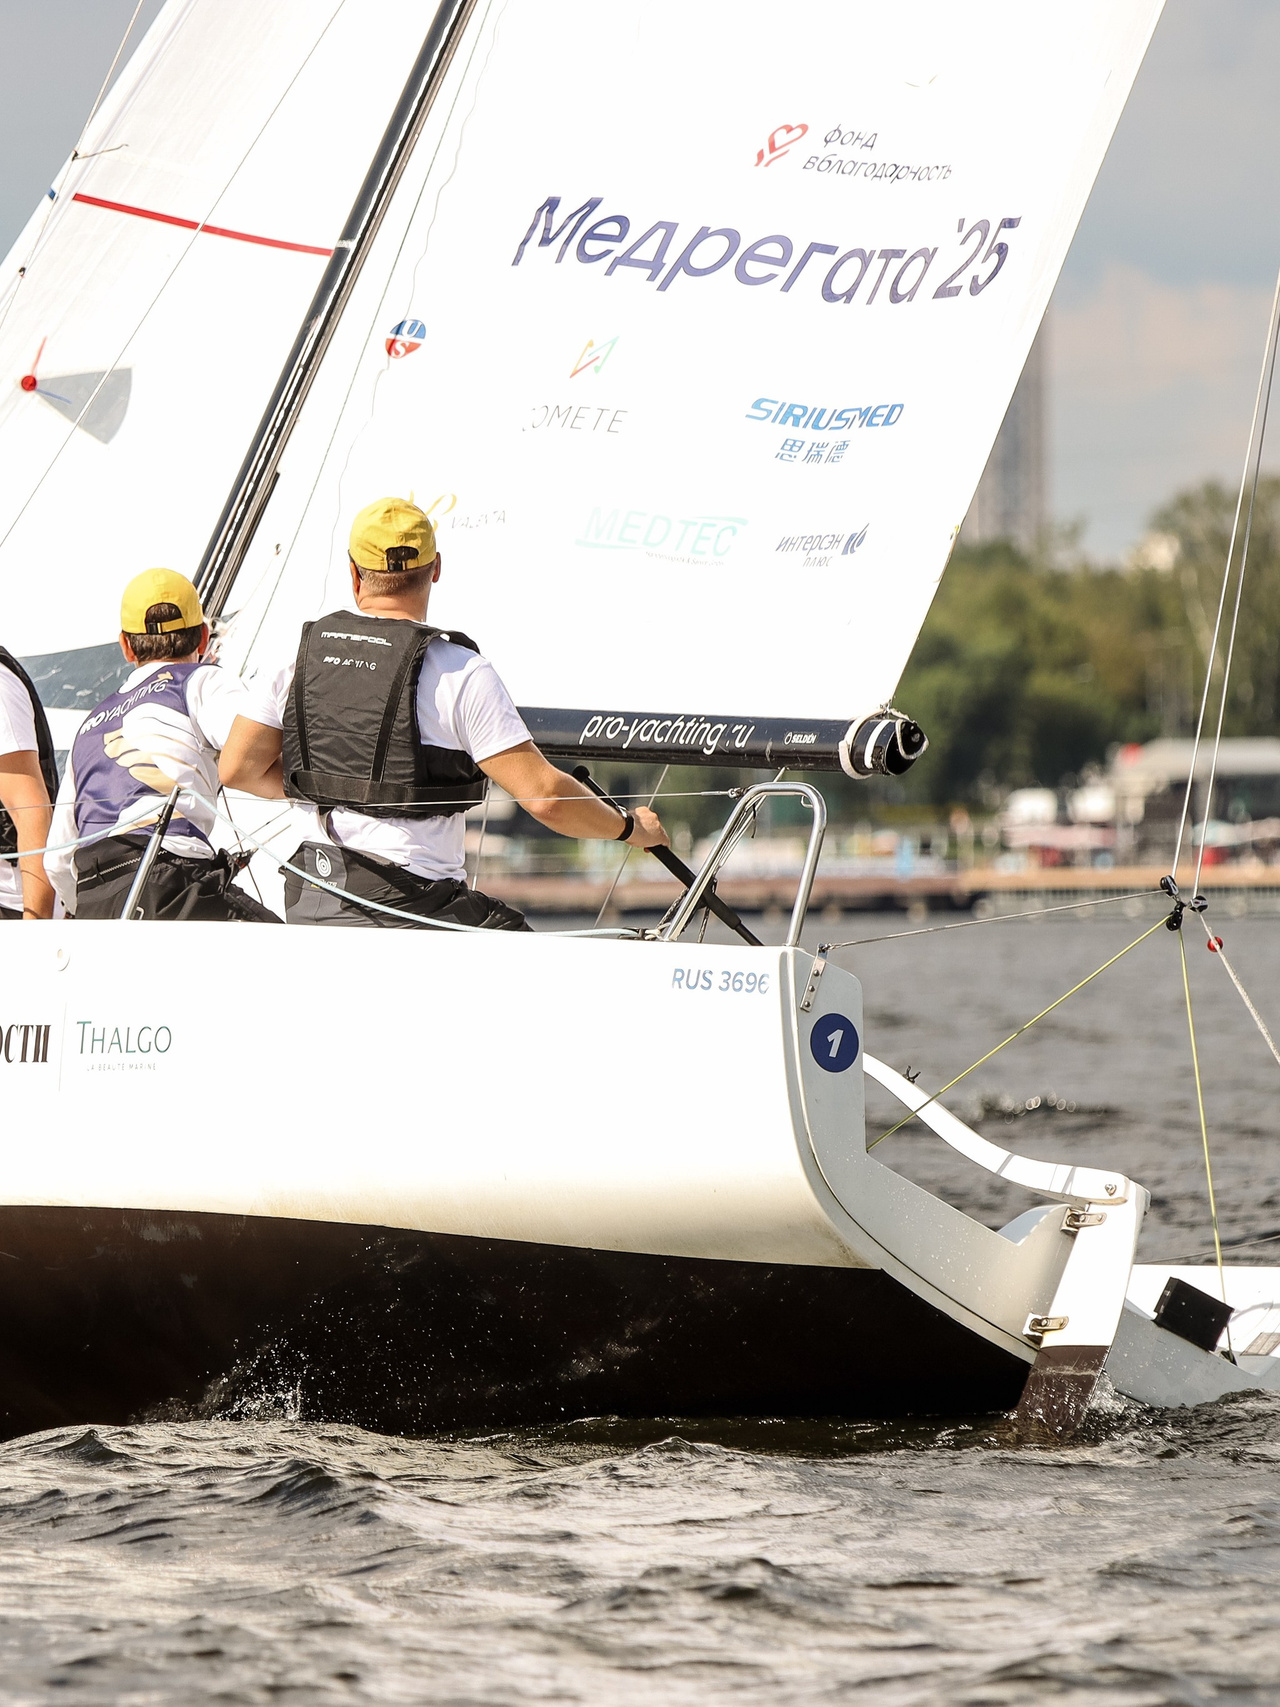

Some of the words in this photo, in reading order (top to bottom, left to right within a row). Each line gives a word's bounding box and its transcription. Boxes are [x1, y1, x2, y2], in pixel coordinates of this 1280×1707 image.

[823, 124, 878, 151] фонд
[511, 196, 939, 305] Медрегата
[932, 216, 1022, 300] '25
[522, 405, 628, 434] OMETE
[745, 397, 905, 431] SIRIUSMED
[671, 968, 714, 991] RUS
[826, 1028, 844, 1059] 1
